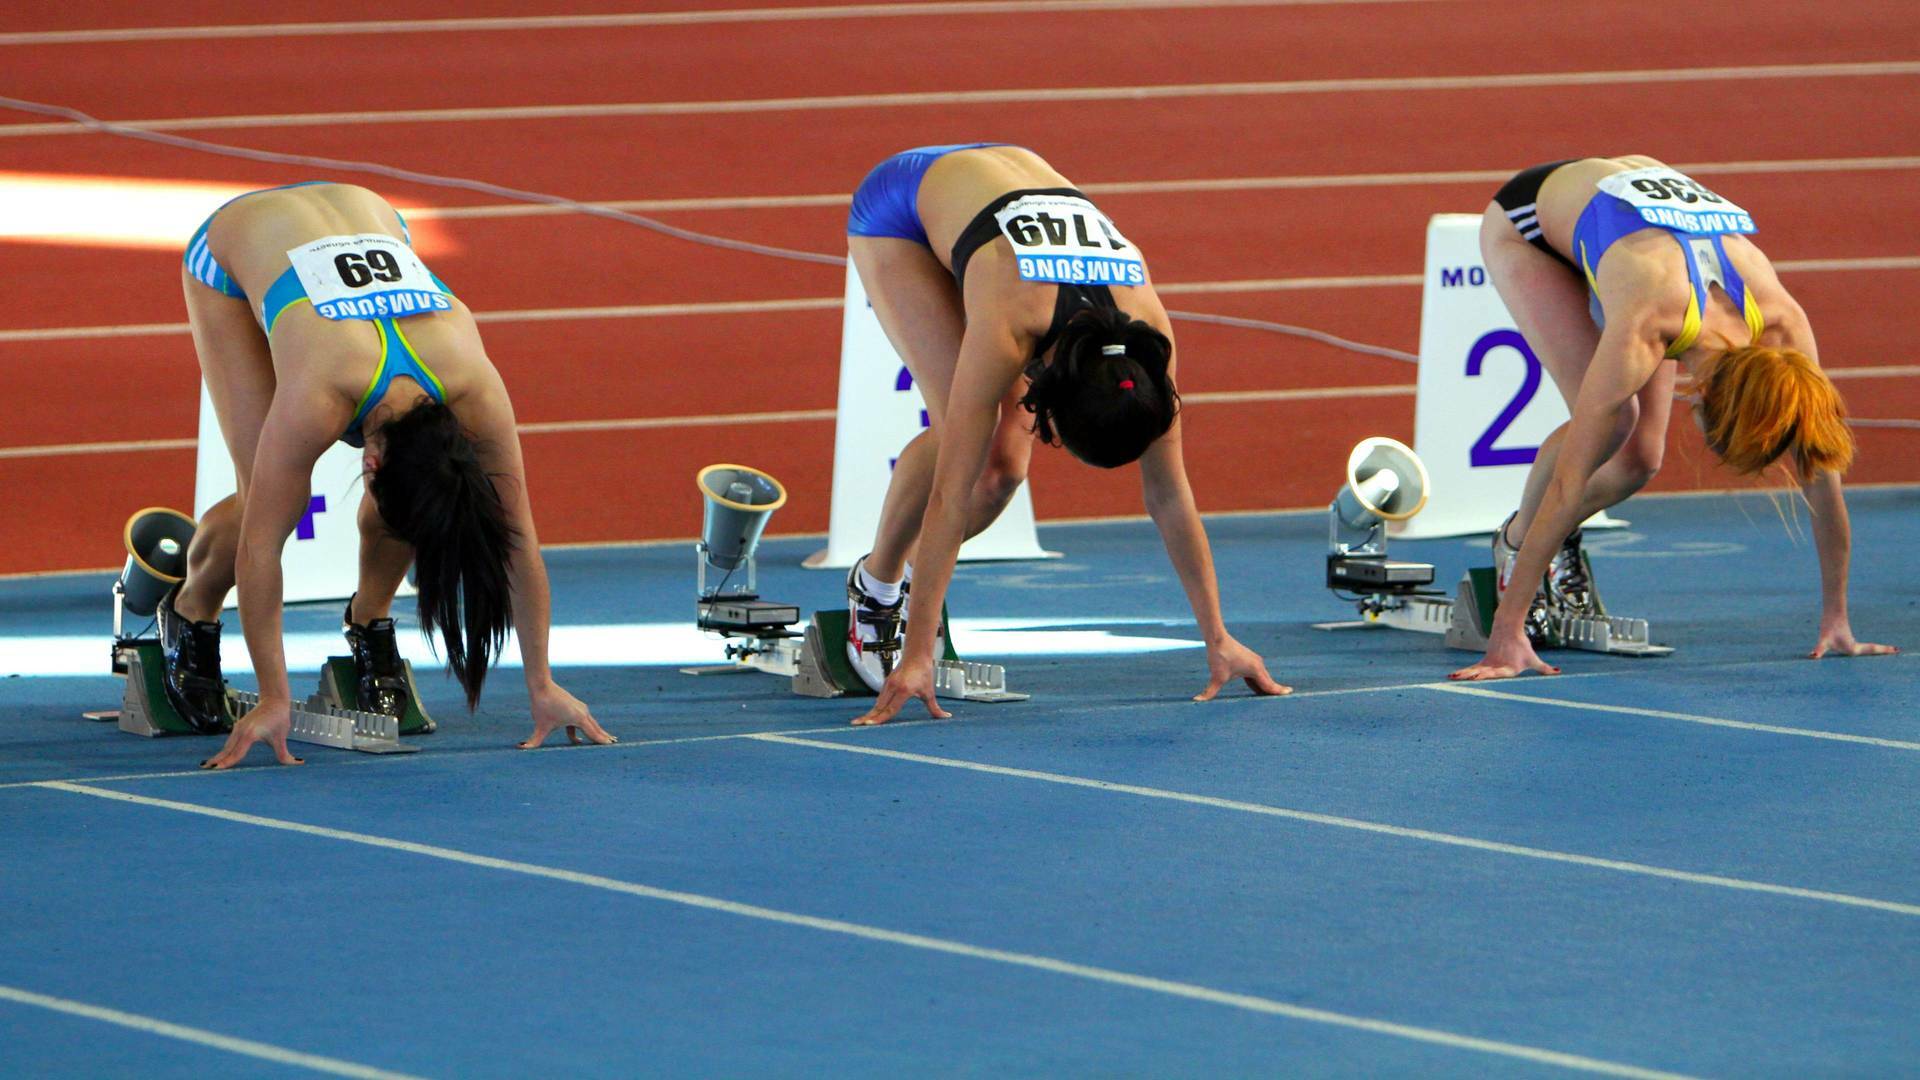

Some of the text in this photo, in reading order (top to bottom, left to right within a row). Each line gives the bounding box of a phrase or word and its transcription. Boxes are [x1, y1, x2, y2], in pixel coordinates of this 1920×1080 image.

[1005, 212, 1126, 251] 1749
[1641, 207, 1754, 233] SAMSUNG
[334, 249, 402, 288] 69
[1019, 257, 1143, 283] SAMSUNG
[319, 292, 449, 319] SAMSUNG
[1465, 328, 1542, 468] 2
